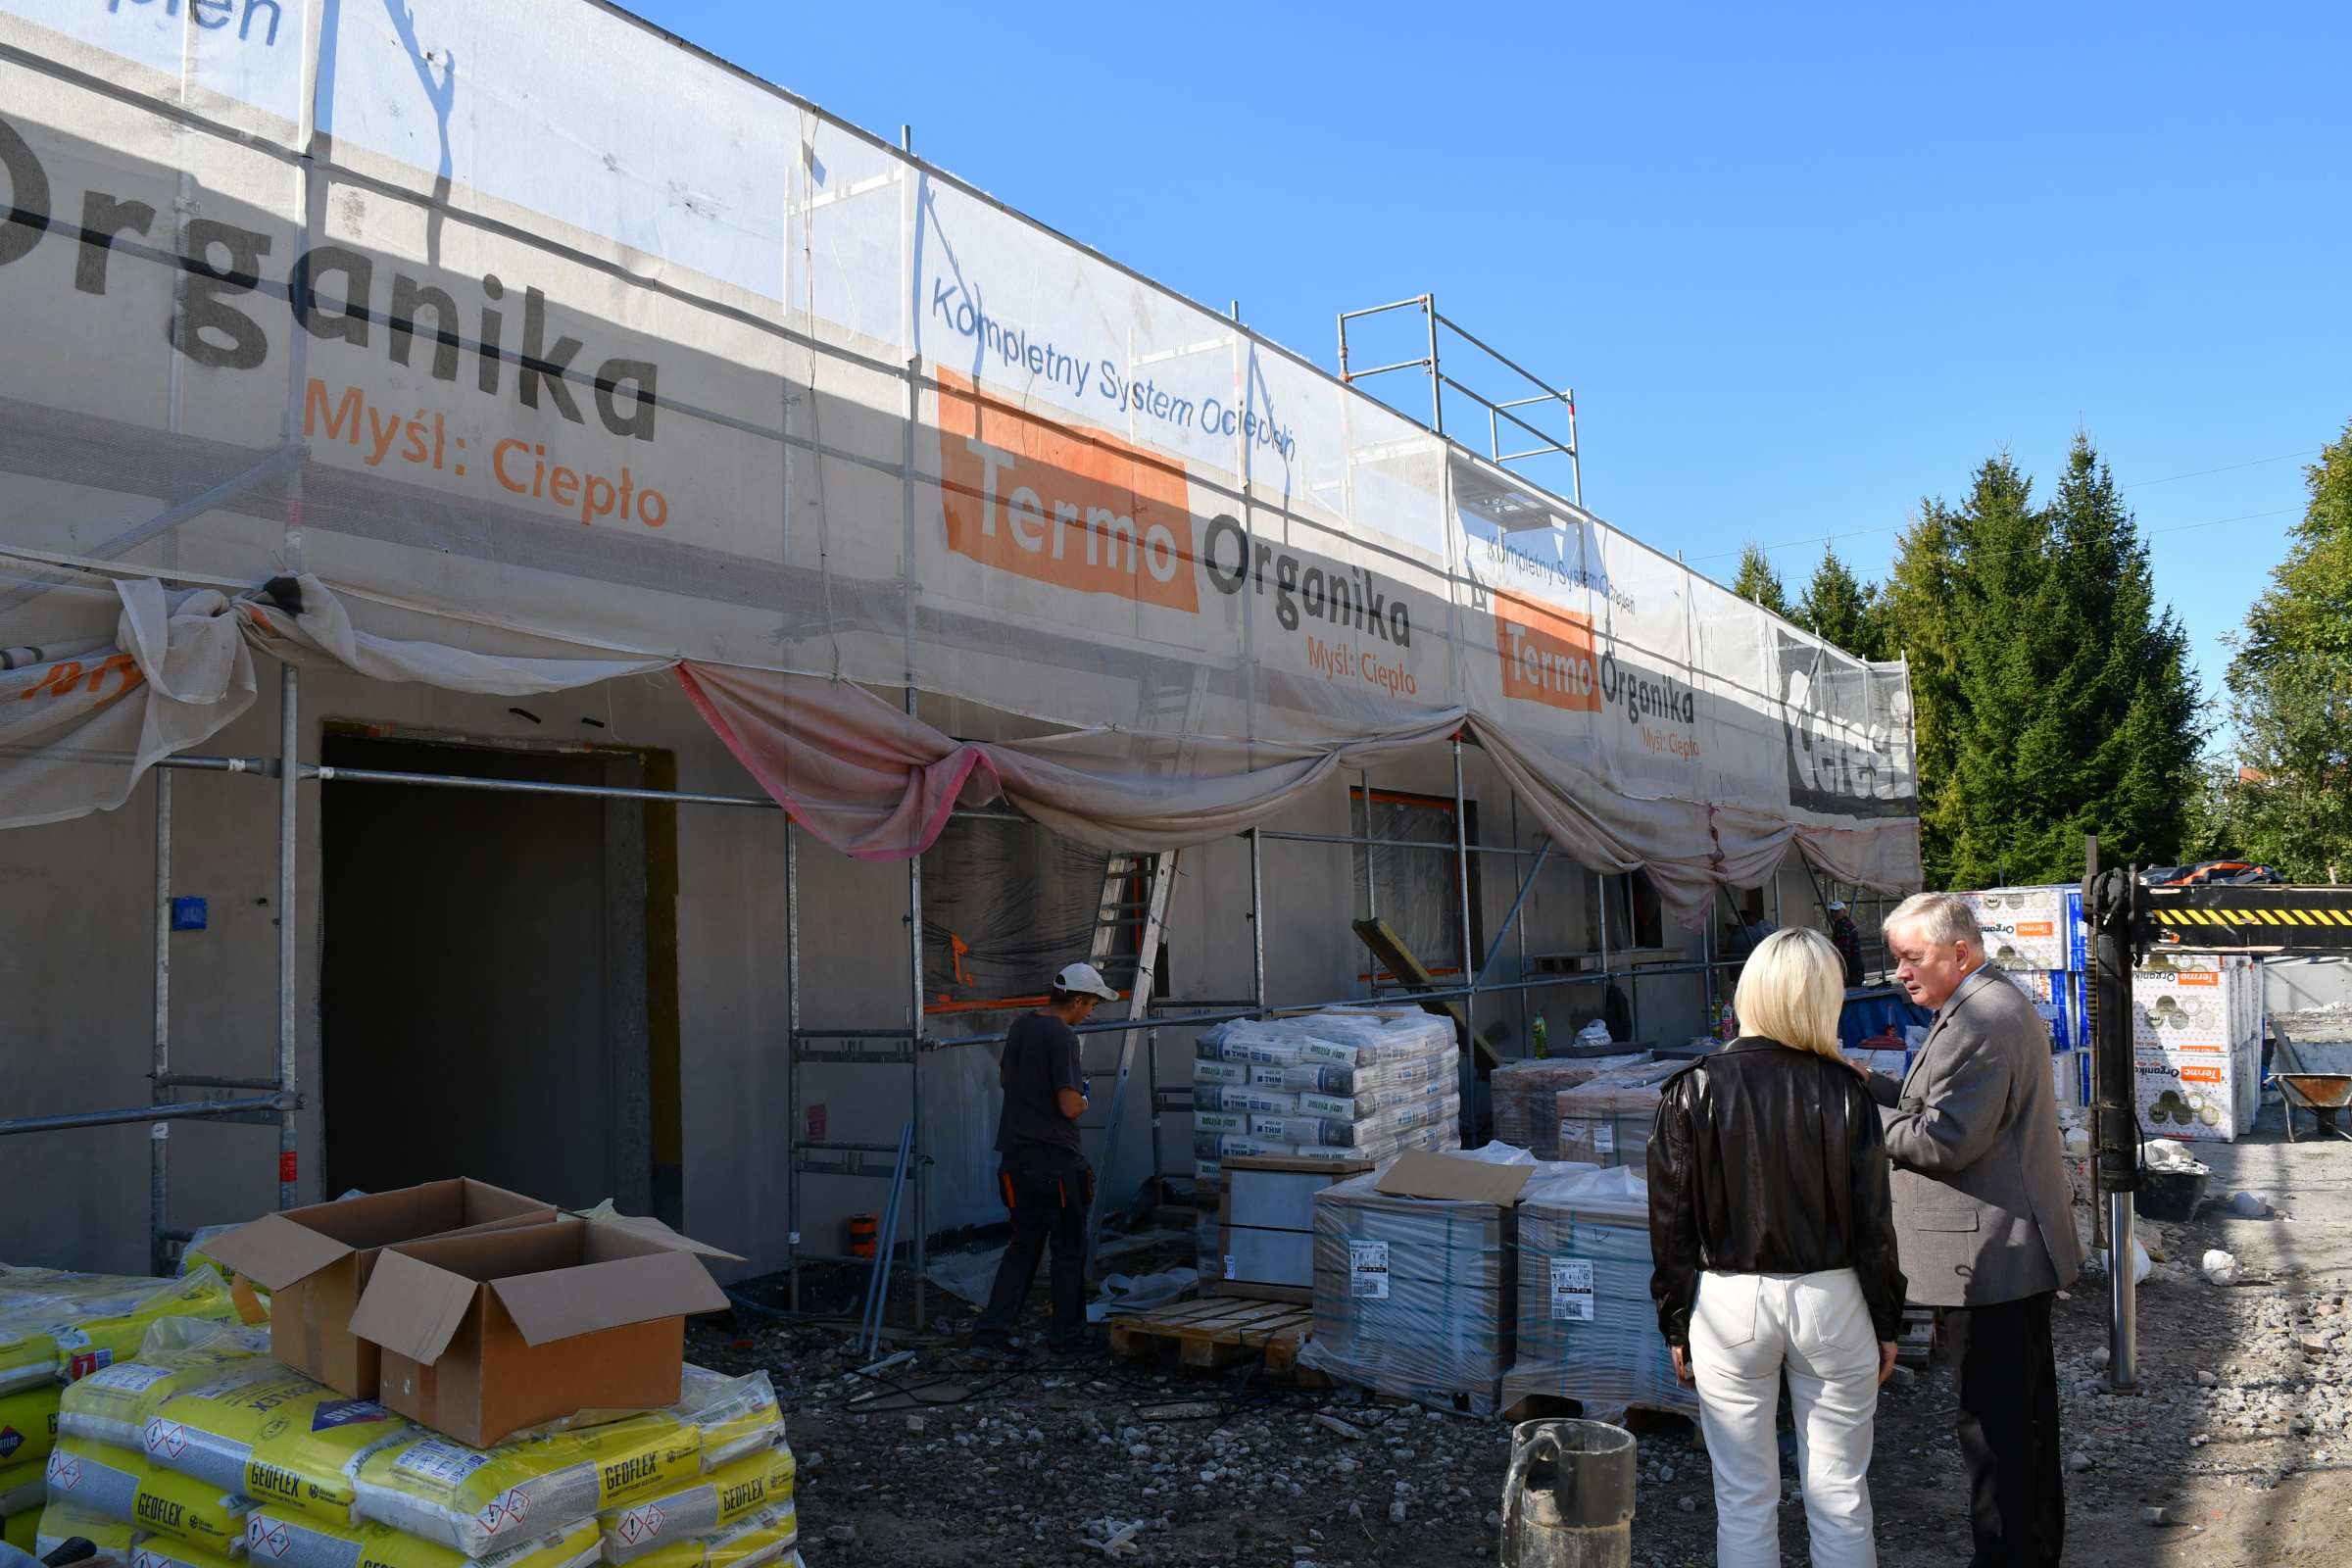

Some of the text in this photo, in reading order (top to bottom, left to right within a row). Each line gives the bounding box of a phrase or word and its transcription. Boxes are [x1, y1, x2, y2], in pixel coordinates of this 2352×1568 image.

[933, 277, 1090, 397] Kompletny
[1100, 361, 1194, 427] System
[305, 377, 667, 526] Myśl: Ciepło
[966, 436, 1410, 648] Termo Organika
[1487, 535, 1553, 586] Kompletny
[1558, 560, 1597, 592] System
[1308, 636, 1416, 697] Myśl: Ciepło
[1505, 622, 1694, 724] Termo Organika
[1642, 726, 1700, 761] Myśl: Ciepło
[1980, 924, 2015, 935] Organi
[2019, 924, 2049, 934] Termo
[2132, 972, 2215, 983] Termo Organik
[2183, 1069, 2217, 1079] Termo
[1230, 1100, 1248, 1108] THM
[251, 1461, 301, 1497] GEOFLEX
[605, 1451, 657, 1491] GEOFLEX
[137, 1493, 183, 1528] GEOFLEX
[723, 1478, 763, 1512] GEOFLEX
